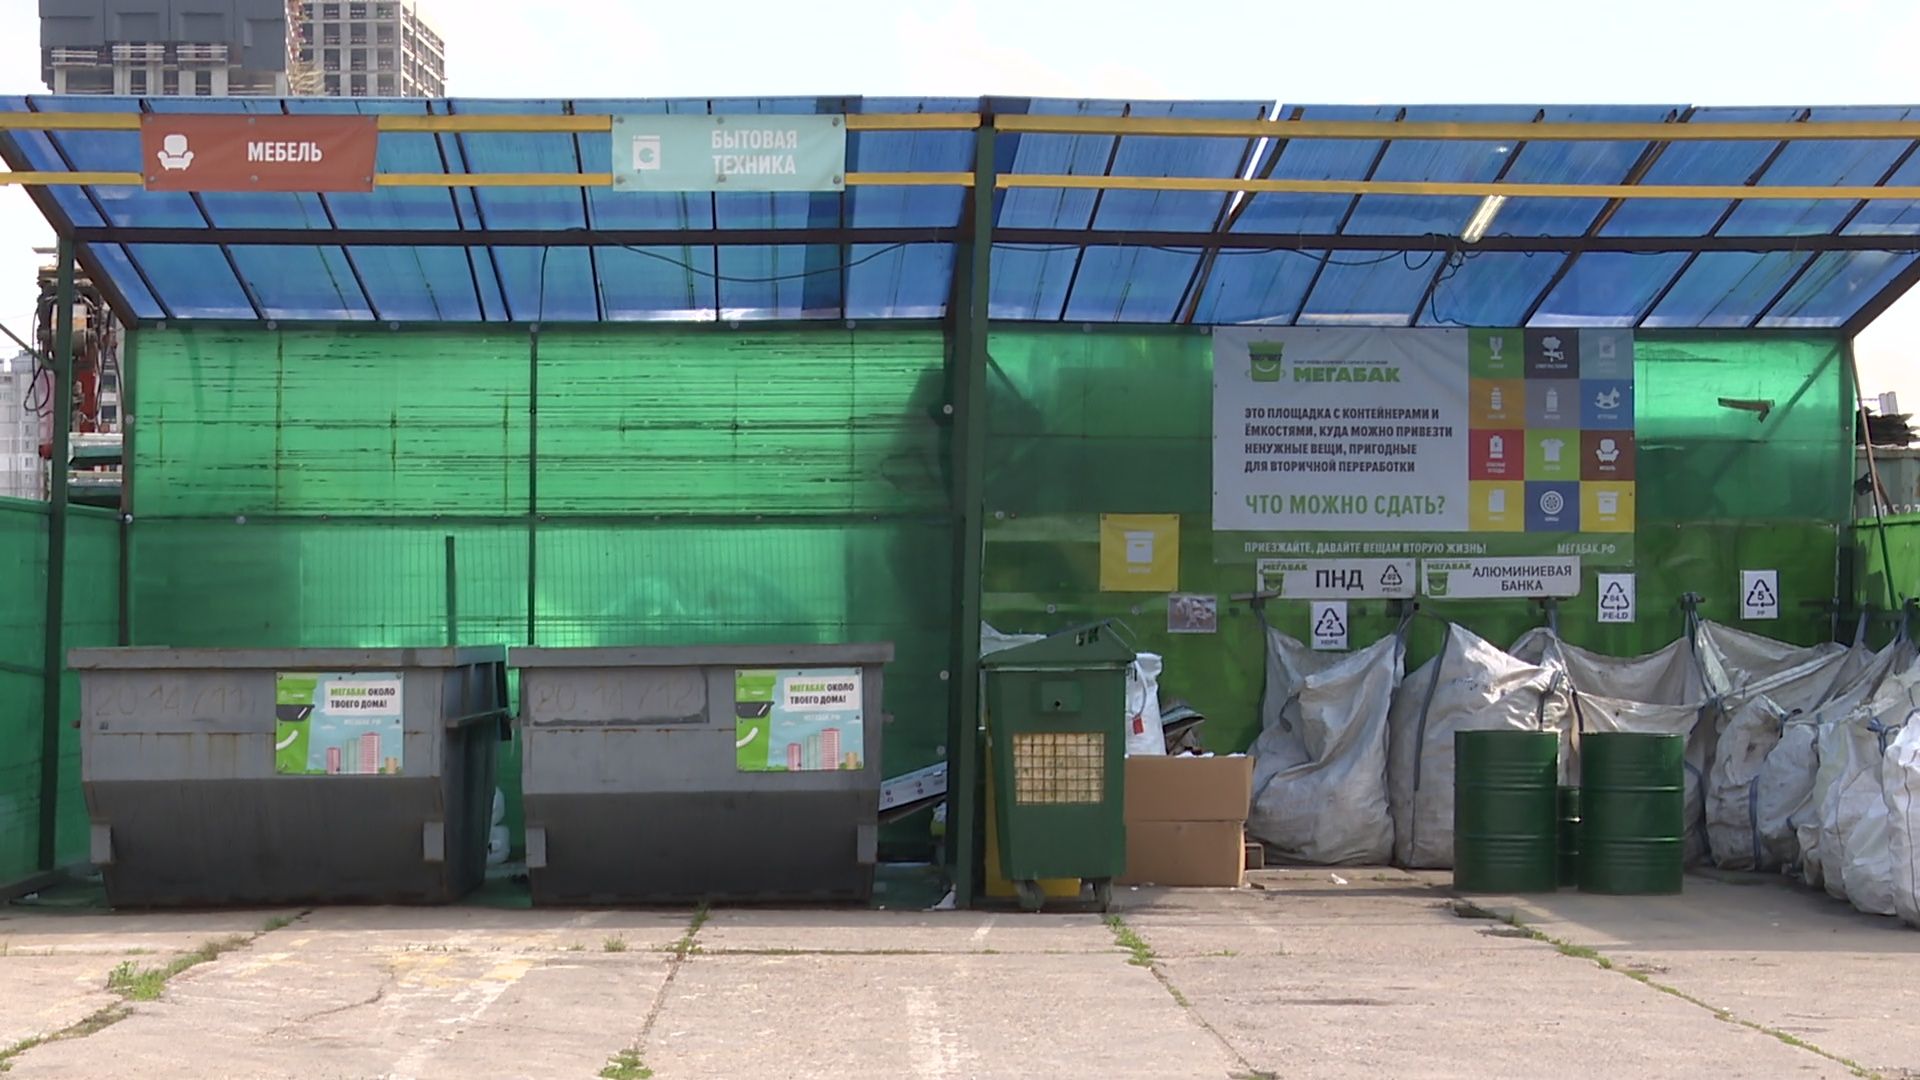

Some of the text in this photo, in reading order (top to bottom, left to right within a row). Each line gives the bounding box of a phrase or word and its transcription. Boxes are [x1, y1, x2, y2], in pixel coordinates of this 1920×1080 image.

[711, 130, 798, 149] БЫТОВАЯ
[247, 141, 323, 162] МЕБЕЛЬ
[711, 155, 797, 175] ТЕХНИКА
[1293, 367, 1400, 382] МЕГАБАК
[1244, 405, 1440, 421] ЭТО ПЛОЩАДКА С КОНТЕЙНЕРАМИ И
[1244, 423, 1453, 438] ЁМКОСТЯМИ, КУДА МОЖНО ПРИВЕЗТИ
[1244, 443, 1417, 456] НЕНУЖНЫЕ ВЕЩИ, ПРИГОДНЫЕ
[1244, 459, 1415, 473] ДЛЯ ВТОРИЧНОЙ ПЕРЕРАБОТКИ
[1245, 494, 1447, 518] ЧТО МОЖНО СДАТЬ?
[1244, 540, 1487, 554] ПРИЕЗЖАЙТЕ, ДАВАЙТЕ ВЕЩАМ ВТОРУЮ ЖИЗНЬ!
[1263, 563, 1308, 571] МЕГАБАК
[1472, 565, 1572, 578] АЛЮМИНИЕВАЯ
[1315, 569, 1364, 590] ПНД
[1501, 580, 1543, 592] БАНКА
[1757, 590, 1765, 601] 5
[1602, 611, 1629, 620] PE-LD
[1325, 619, 1334, 630] 2
[368, 687, 396, 696] ОКОЛО
[826, 682, 855, 692] ОКОЛО
[330, 699, 387, 710] ТВОЕГО ДОМА!
[790, 695, 847, 705] ТВОЕГО ДОМА!
